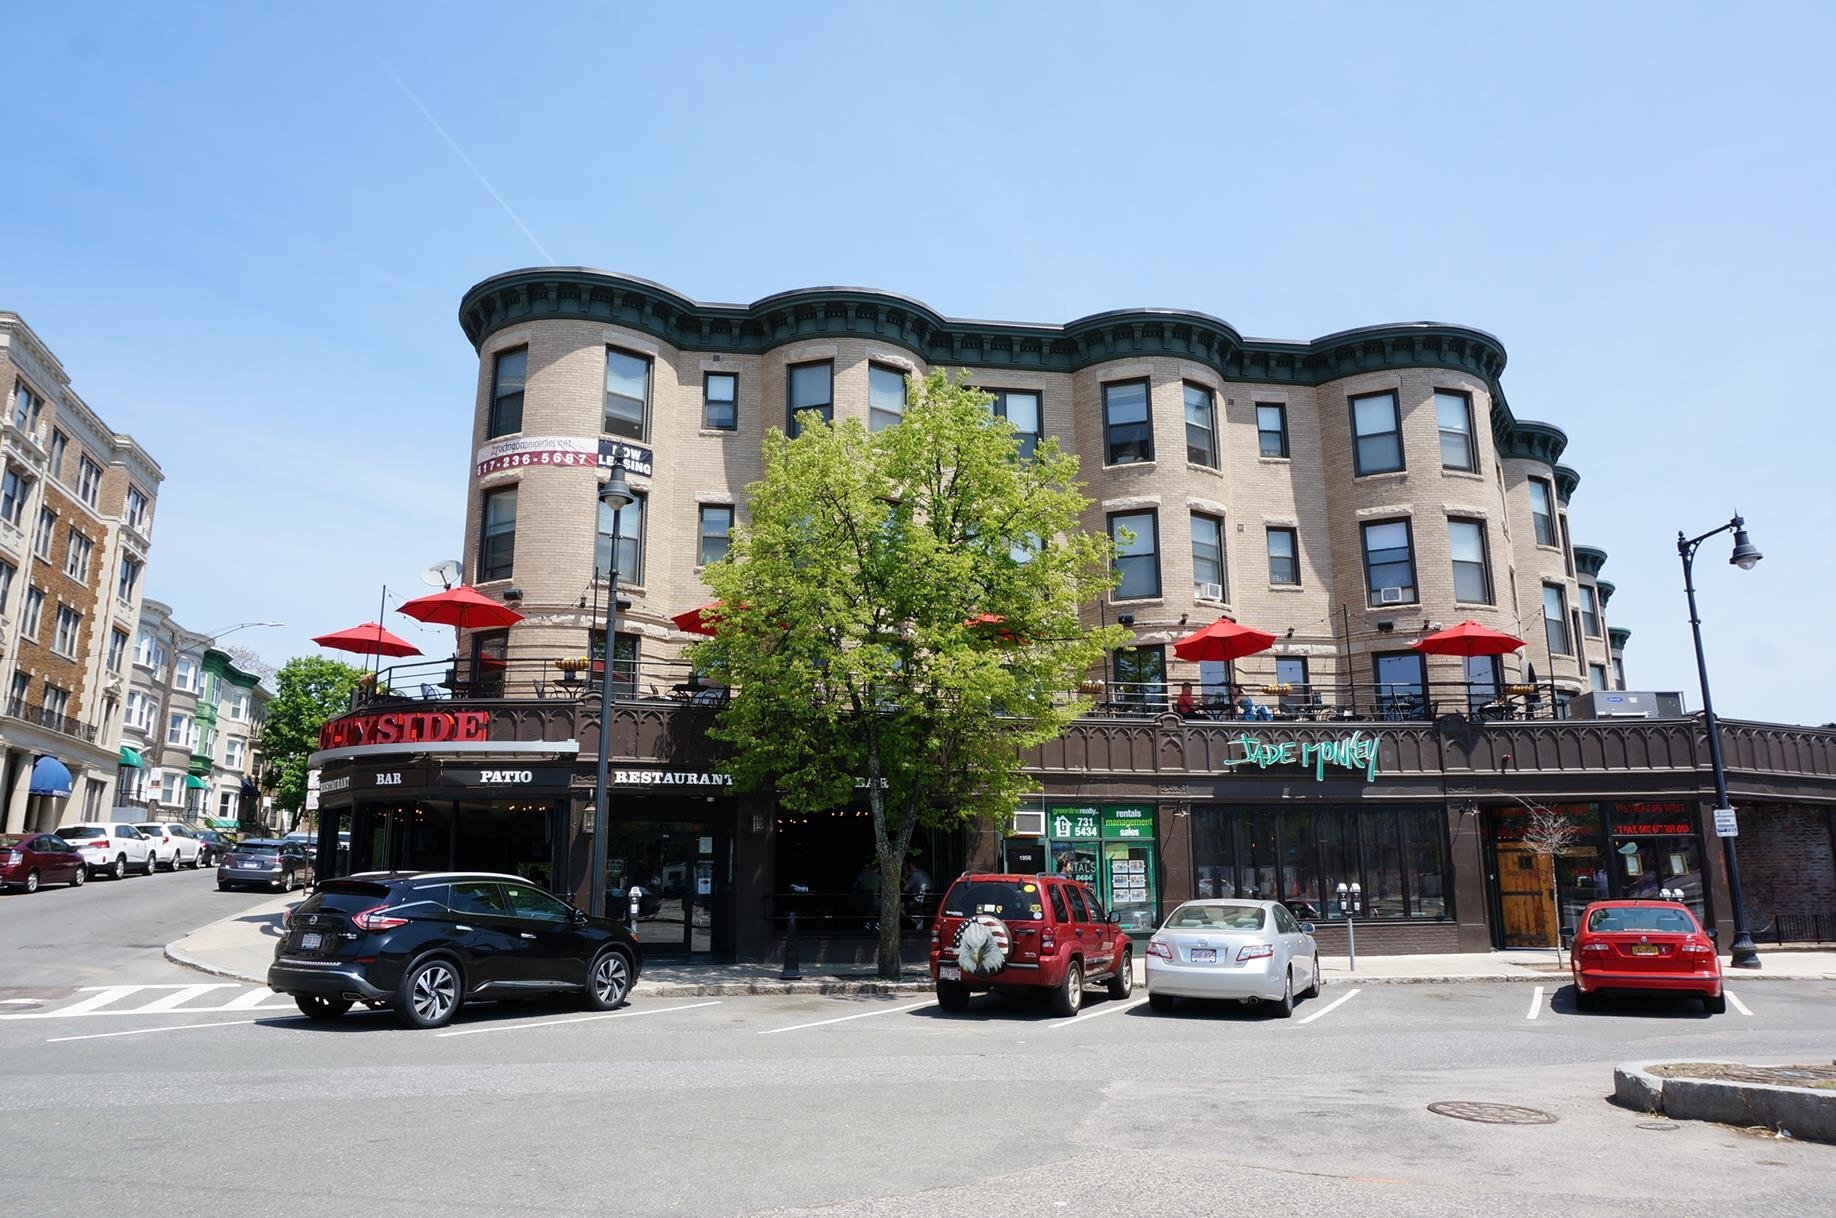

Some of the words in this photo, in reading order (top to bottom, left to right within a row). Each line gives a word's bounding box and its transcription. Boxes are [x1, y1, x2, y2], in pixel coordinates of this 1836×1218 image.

[598, 454, 651, 475] LESING
[318, 711, 490, 751] CITYSIDE
[1224, 732, 1296, 769] JADE
[376, 772, 402, 785] BAR
[480, 770, 533, 784] PATIO
[1116, 809, 1142, 818] rentals
[1077, 817, 1093, 827] 731
[1105, 818, 1153, 828] management
[1074, 827, 1098, 837] 5434
[1120, 828, 1140, 837] sales
